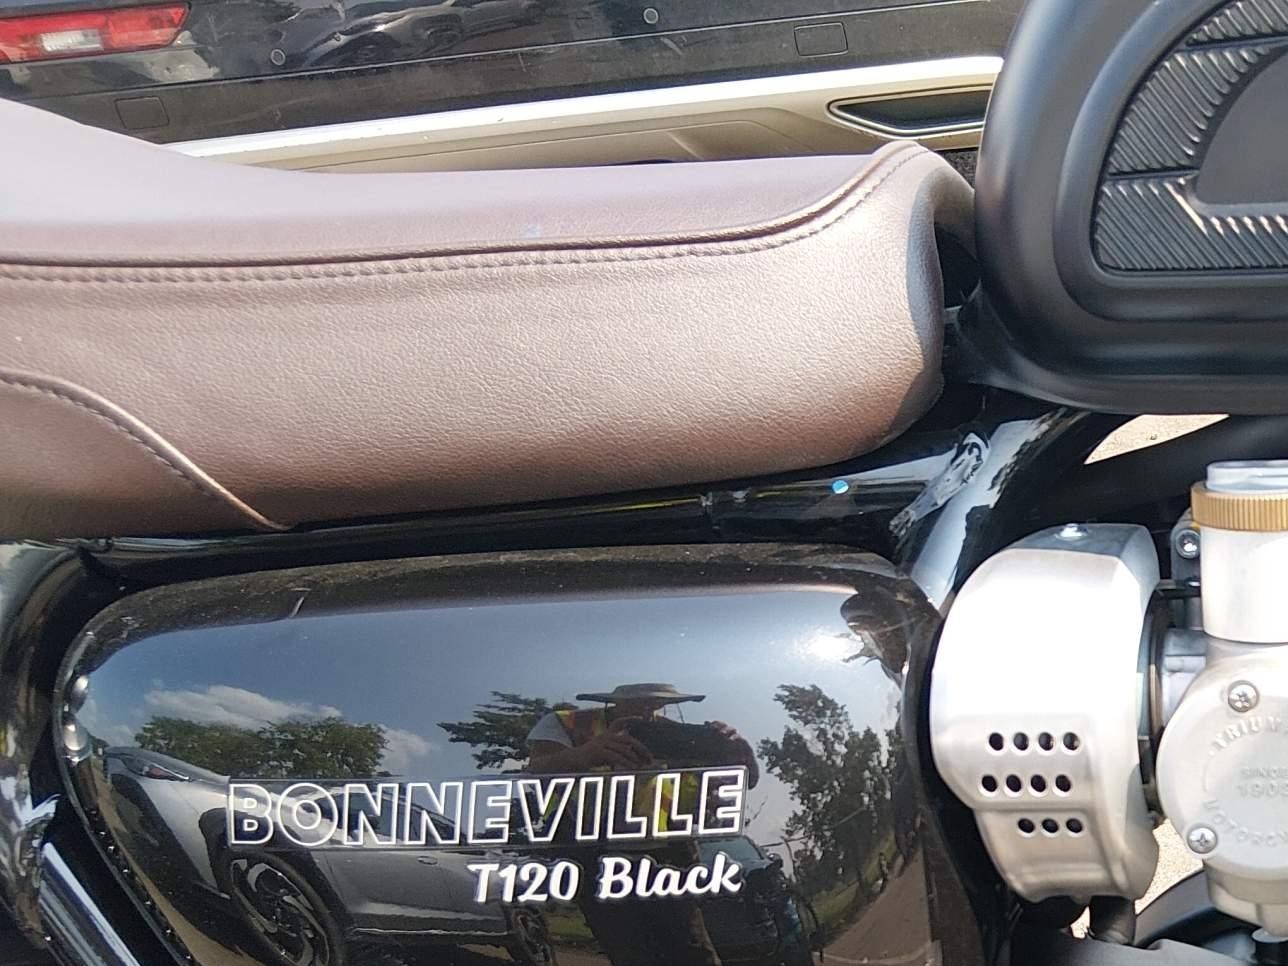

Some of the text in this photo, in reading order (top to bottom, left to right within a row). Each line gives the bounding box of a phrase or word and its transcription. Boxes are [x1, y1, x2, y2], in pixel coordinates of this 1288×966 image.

[1240, 767, 1288, 779] SINCE
[229, 769, 747, 846] BONNEVILLE
[467, 852, 743, 904] T120 Black
